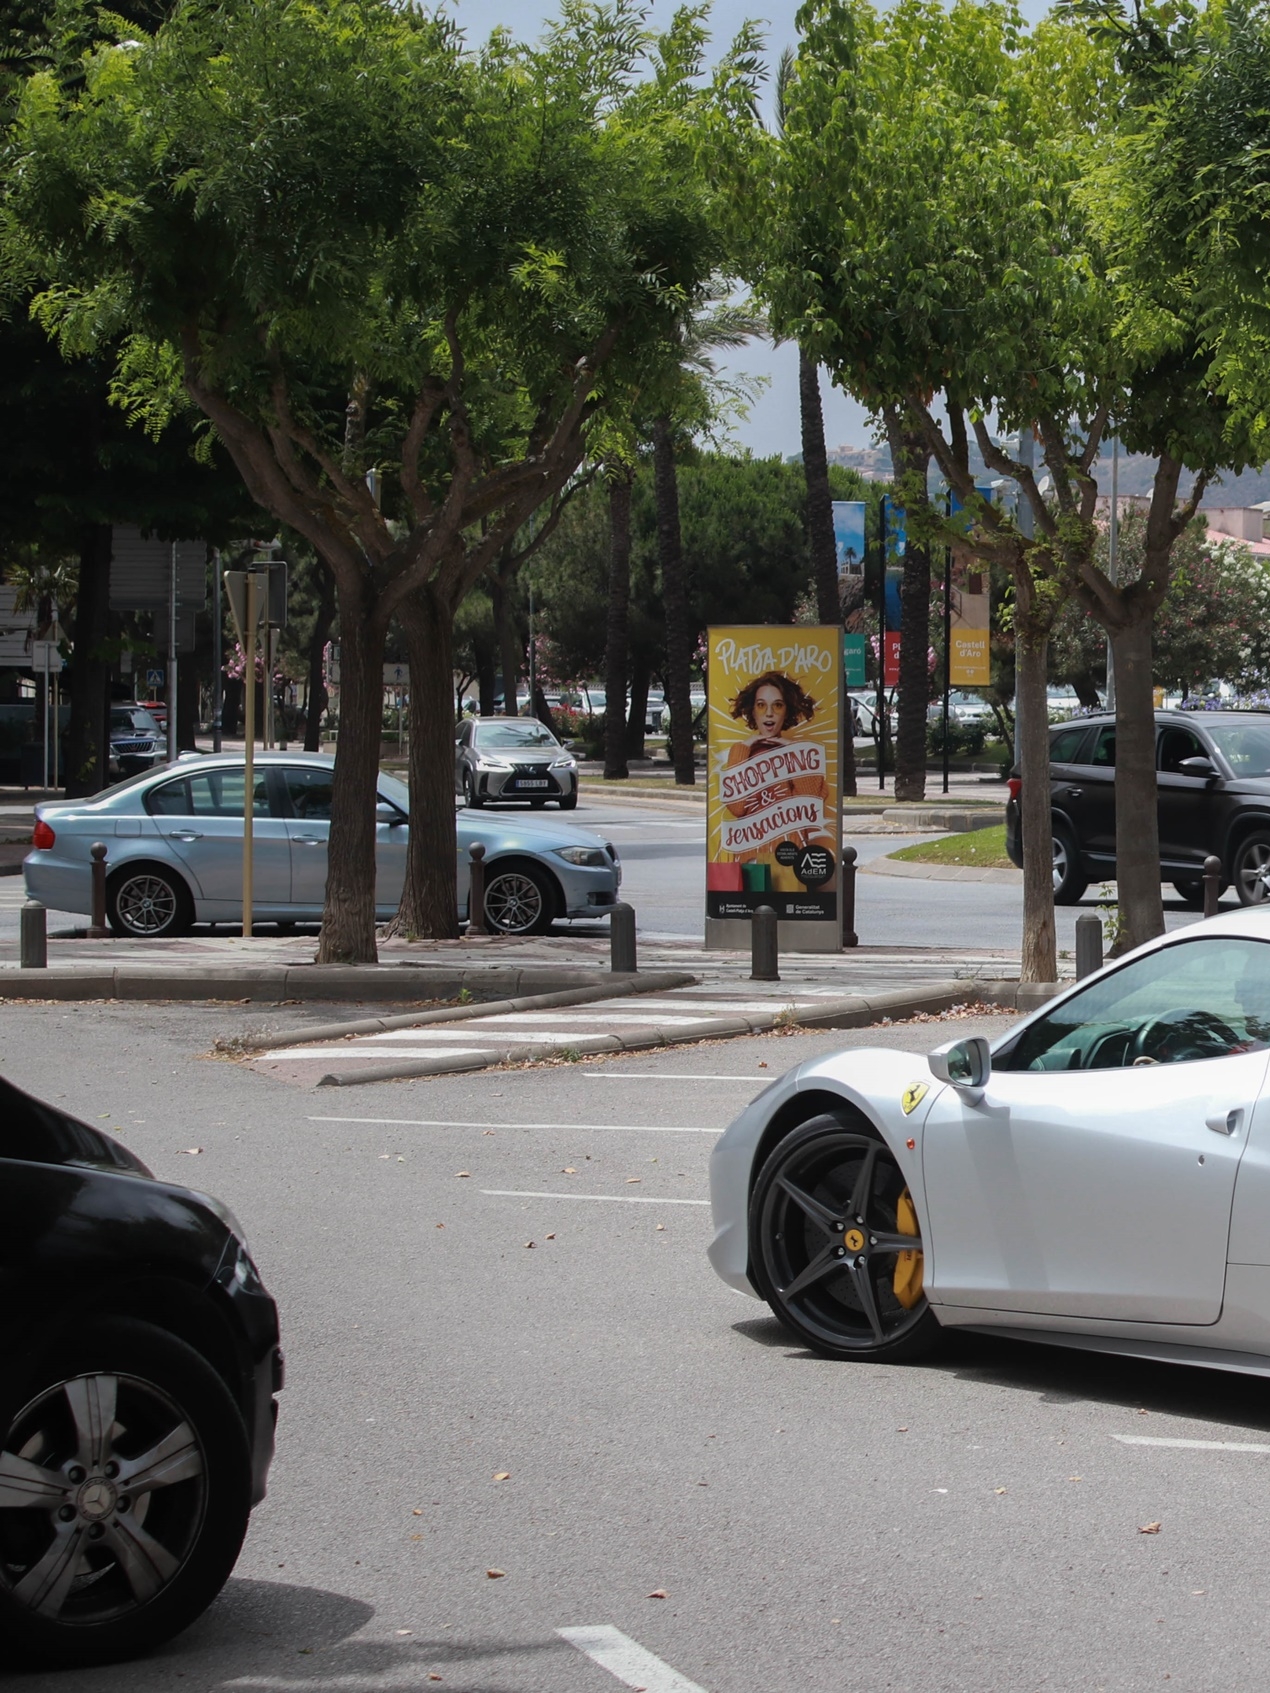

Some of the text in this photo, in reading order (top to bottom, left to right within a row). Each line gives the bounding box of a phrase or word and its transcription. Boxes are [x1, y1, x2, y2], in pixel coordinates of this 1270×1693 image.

[844, 646, 862, 656] garó
[955, 640, 986, 649] Castell
[715, 638, 832, 675] PLATJA D'ARO
[959, 649, 981, 658] d'Aro
[722, 747, 820, 799] SHOPPING
[761, 790, 776, 806] &
[725, 803, 820, 847] sensacions
